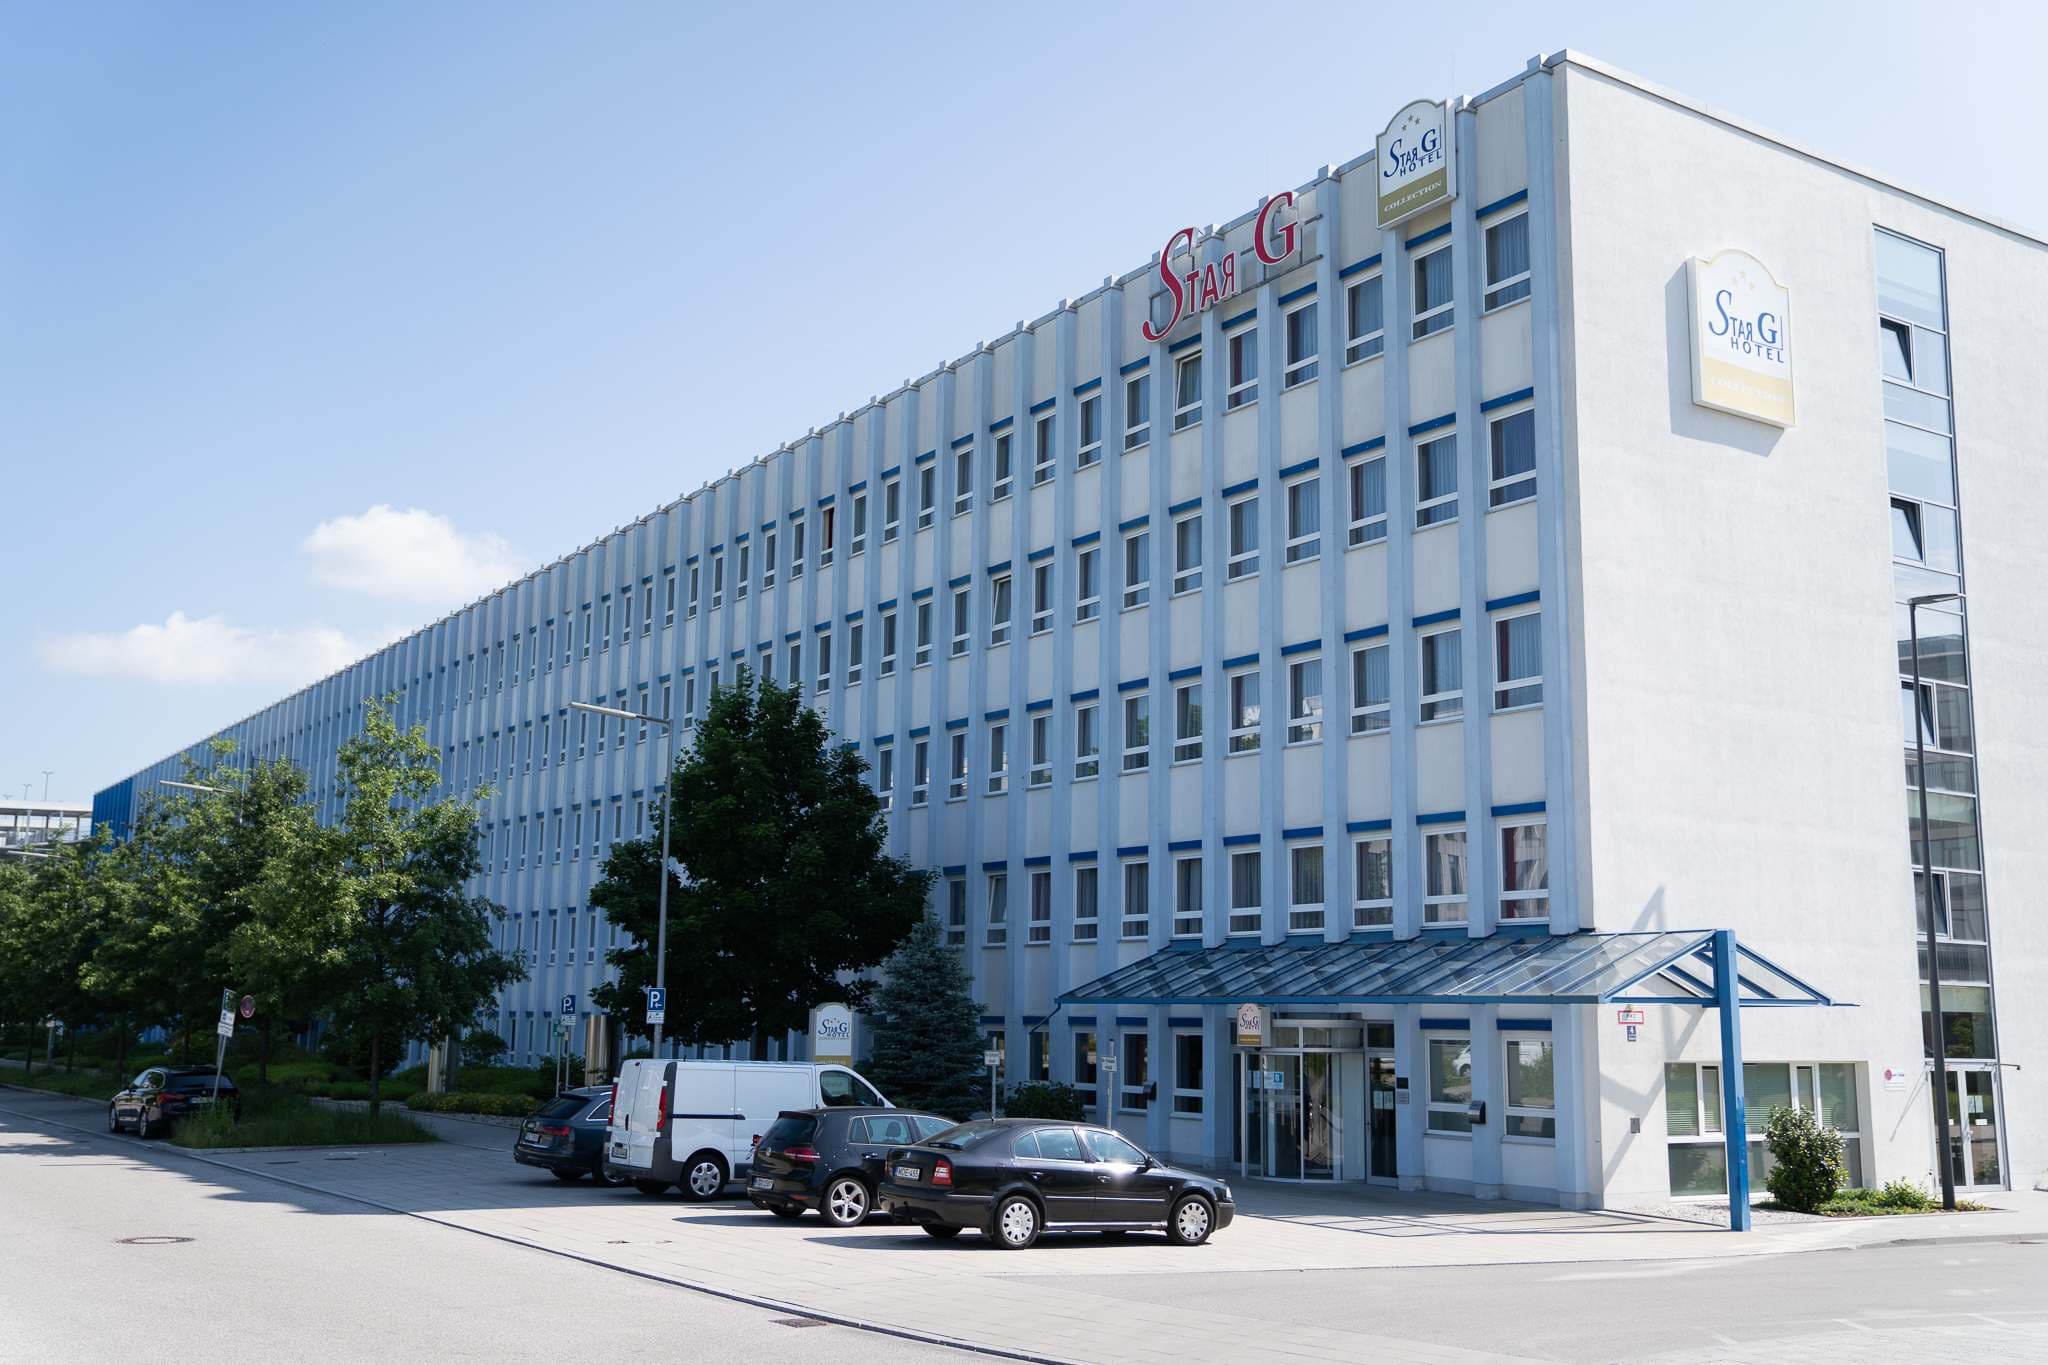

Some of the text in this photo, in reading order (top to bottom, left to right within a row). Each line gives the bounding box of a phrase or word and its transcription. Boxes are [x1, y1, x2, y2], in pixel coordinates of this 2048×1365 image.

[1421, 129, 1438, 153] G
[1400, 150, 1442, 177] HOTEL
[1384, 180, 1443, 212] COLLECTION
[1254, 191, 1298, 266] G
[1757, 312, 1778, 344] G
[1730, 336, 1785, 364] HOTEL
[650, 991, 661, 1009] P
